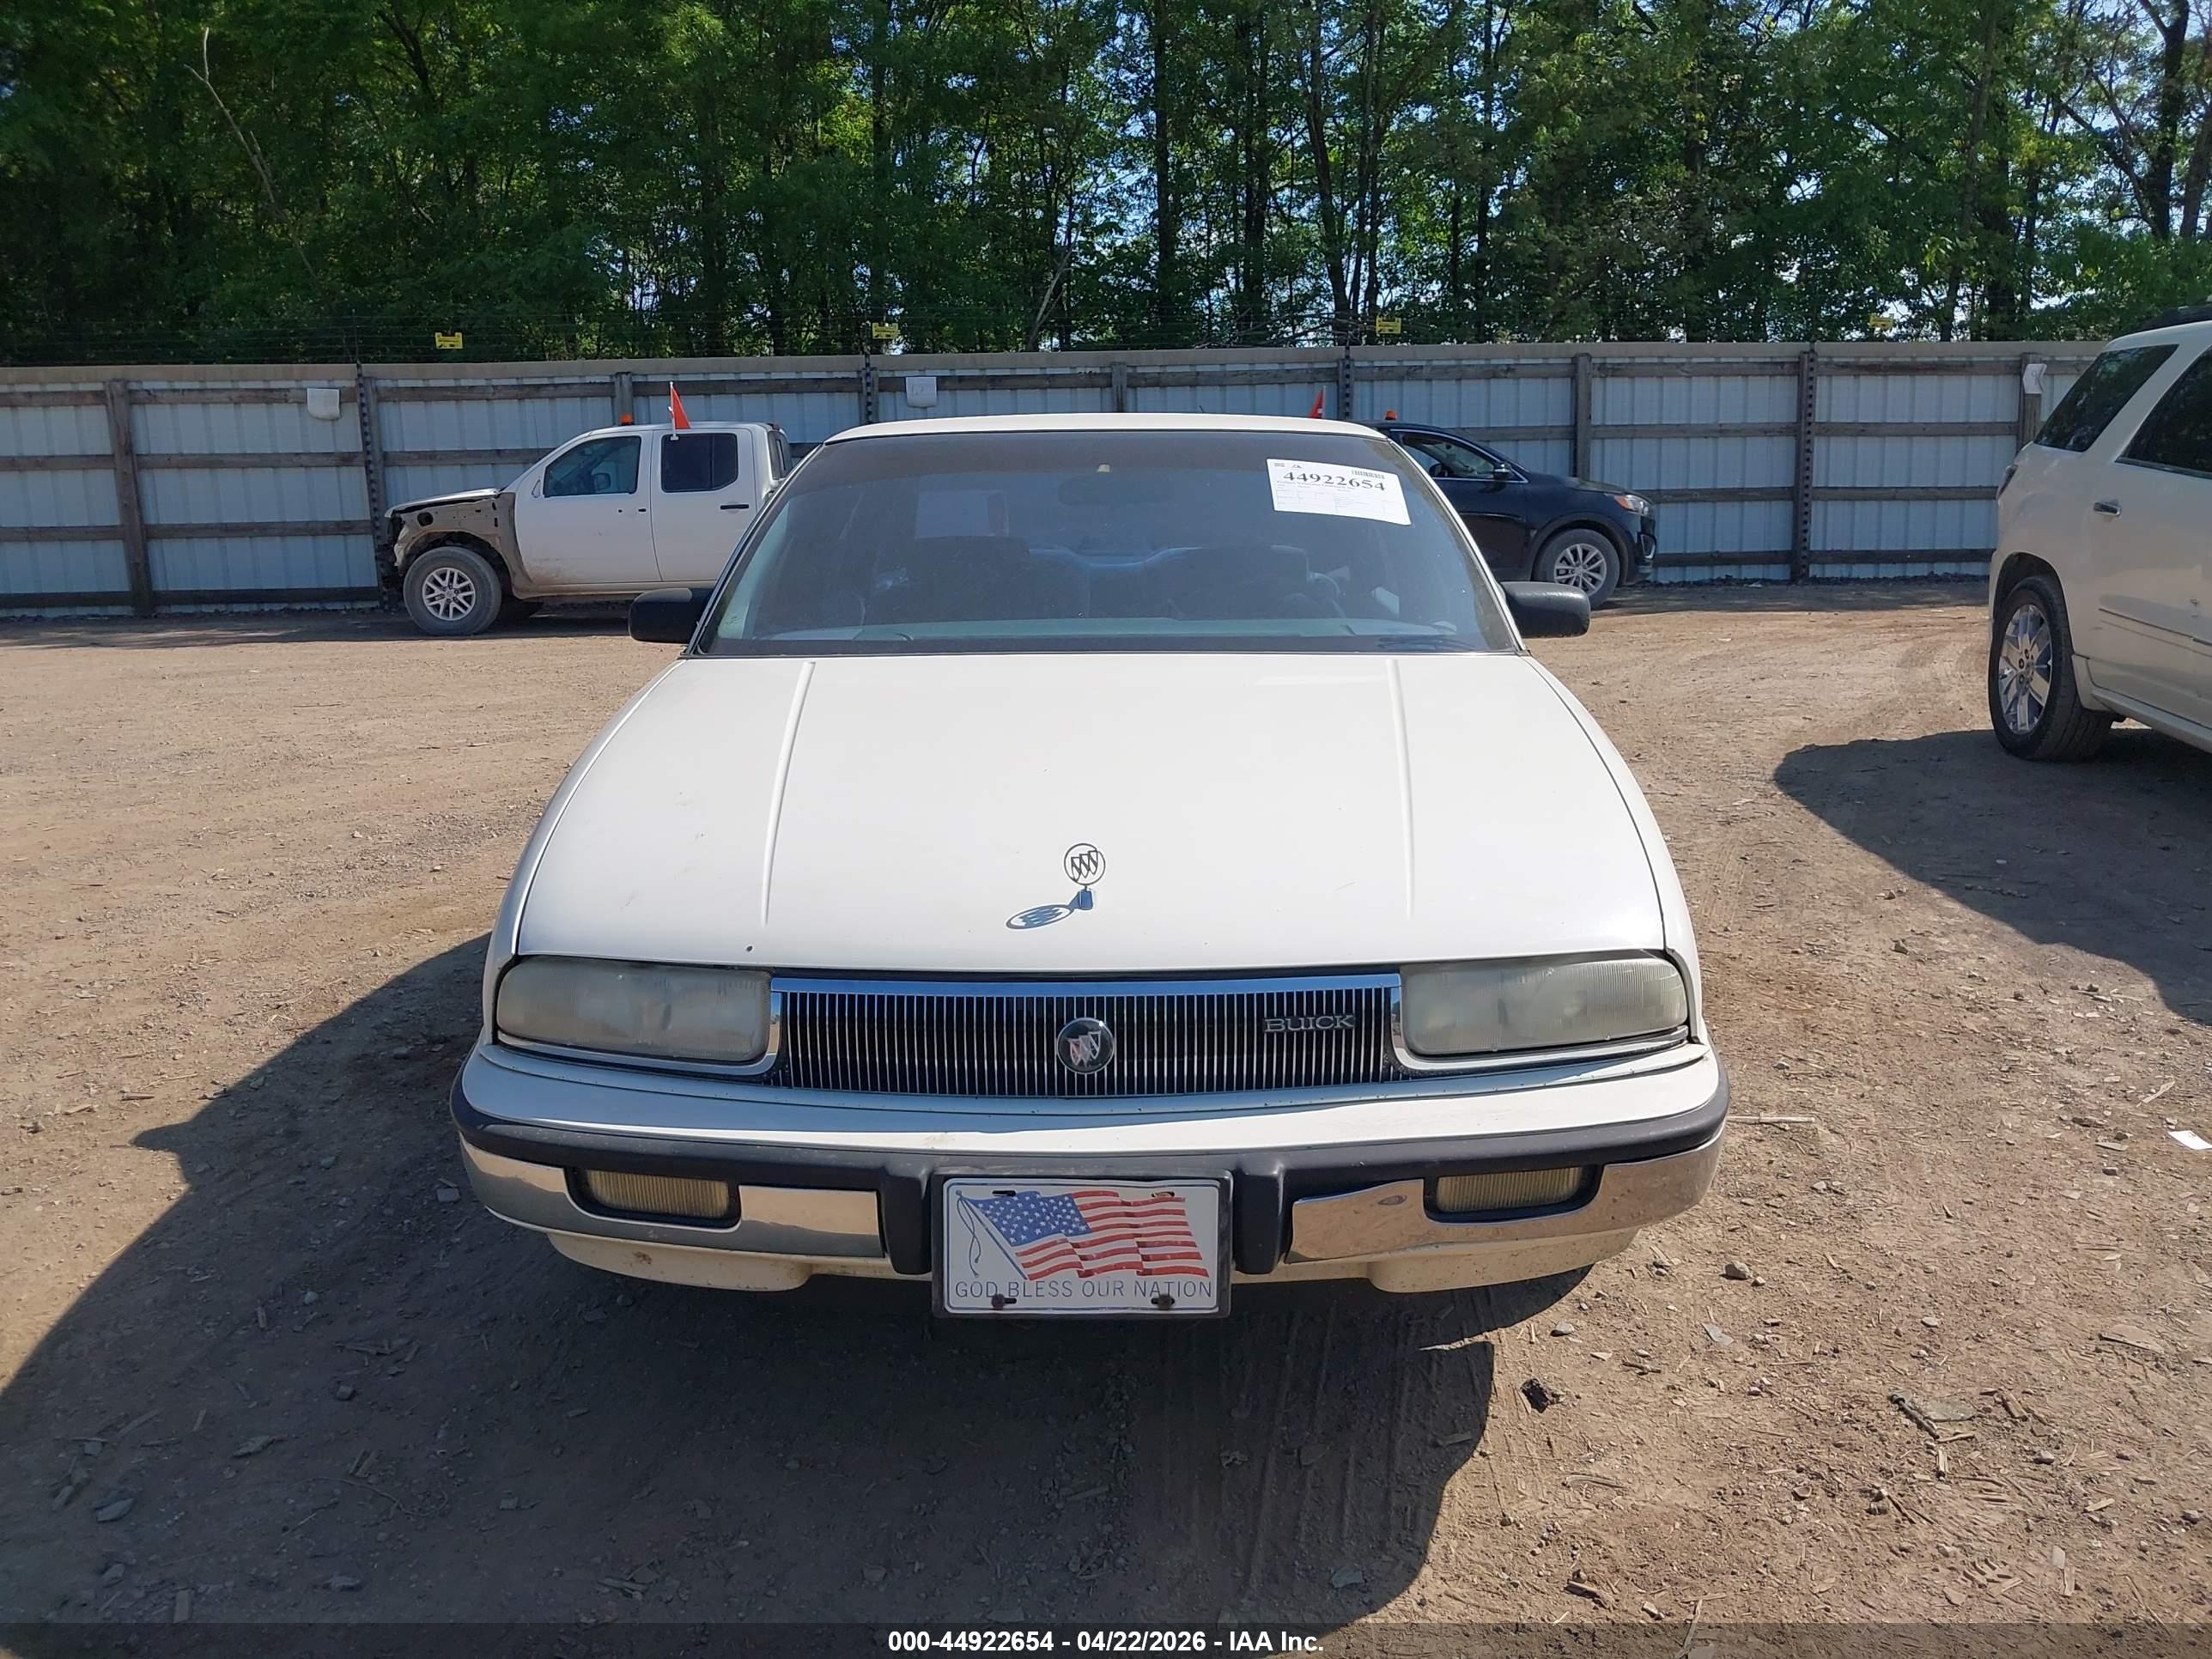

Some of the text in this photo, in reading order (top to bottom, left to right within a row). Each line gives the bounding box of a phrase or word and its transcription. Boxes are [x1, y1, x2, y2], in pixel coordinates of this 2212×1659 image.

[1283, 471, 1385, 491] 44922654
[1264, 1014, 1355, 1032] BUICK
[955, 1280, 1212, 1298] GOD BLESS OUR NATION
